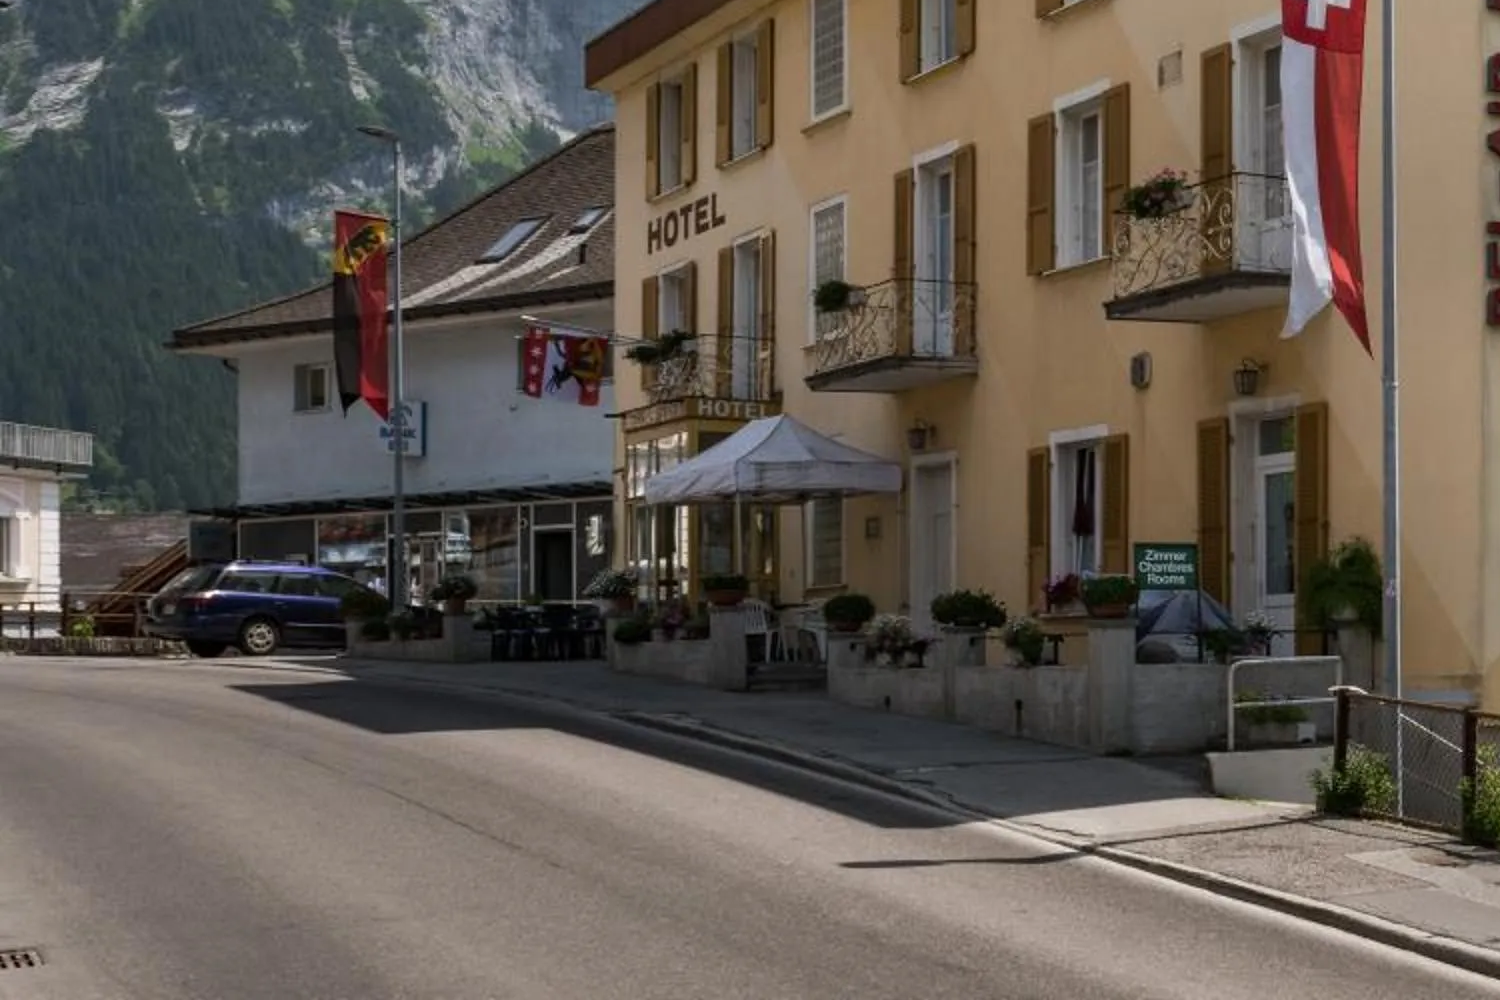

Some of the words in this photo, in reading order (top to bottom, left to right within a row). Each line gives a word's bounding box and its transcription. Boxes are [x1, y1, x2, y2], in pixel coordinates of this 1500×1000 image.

[647, 192, 726, 255] HOTEL
[699, 399, 768, 420] HOTEL
[1144, 549, 1187, 561] Zimmer
[1139, 561, 1194, 573] Chambres
[1147, 573, 1186, 585] Rooms
